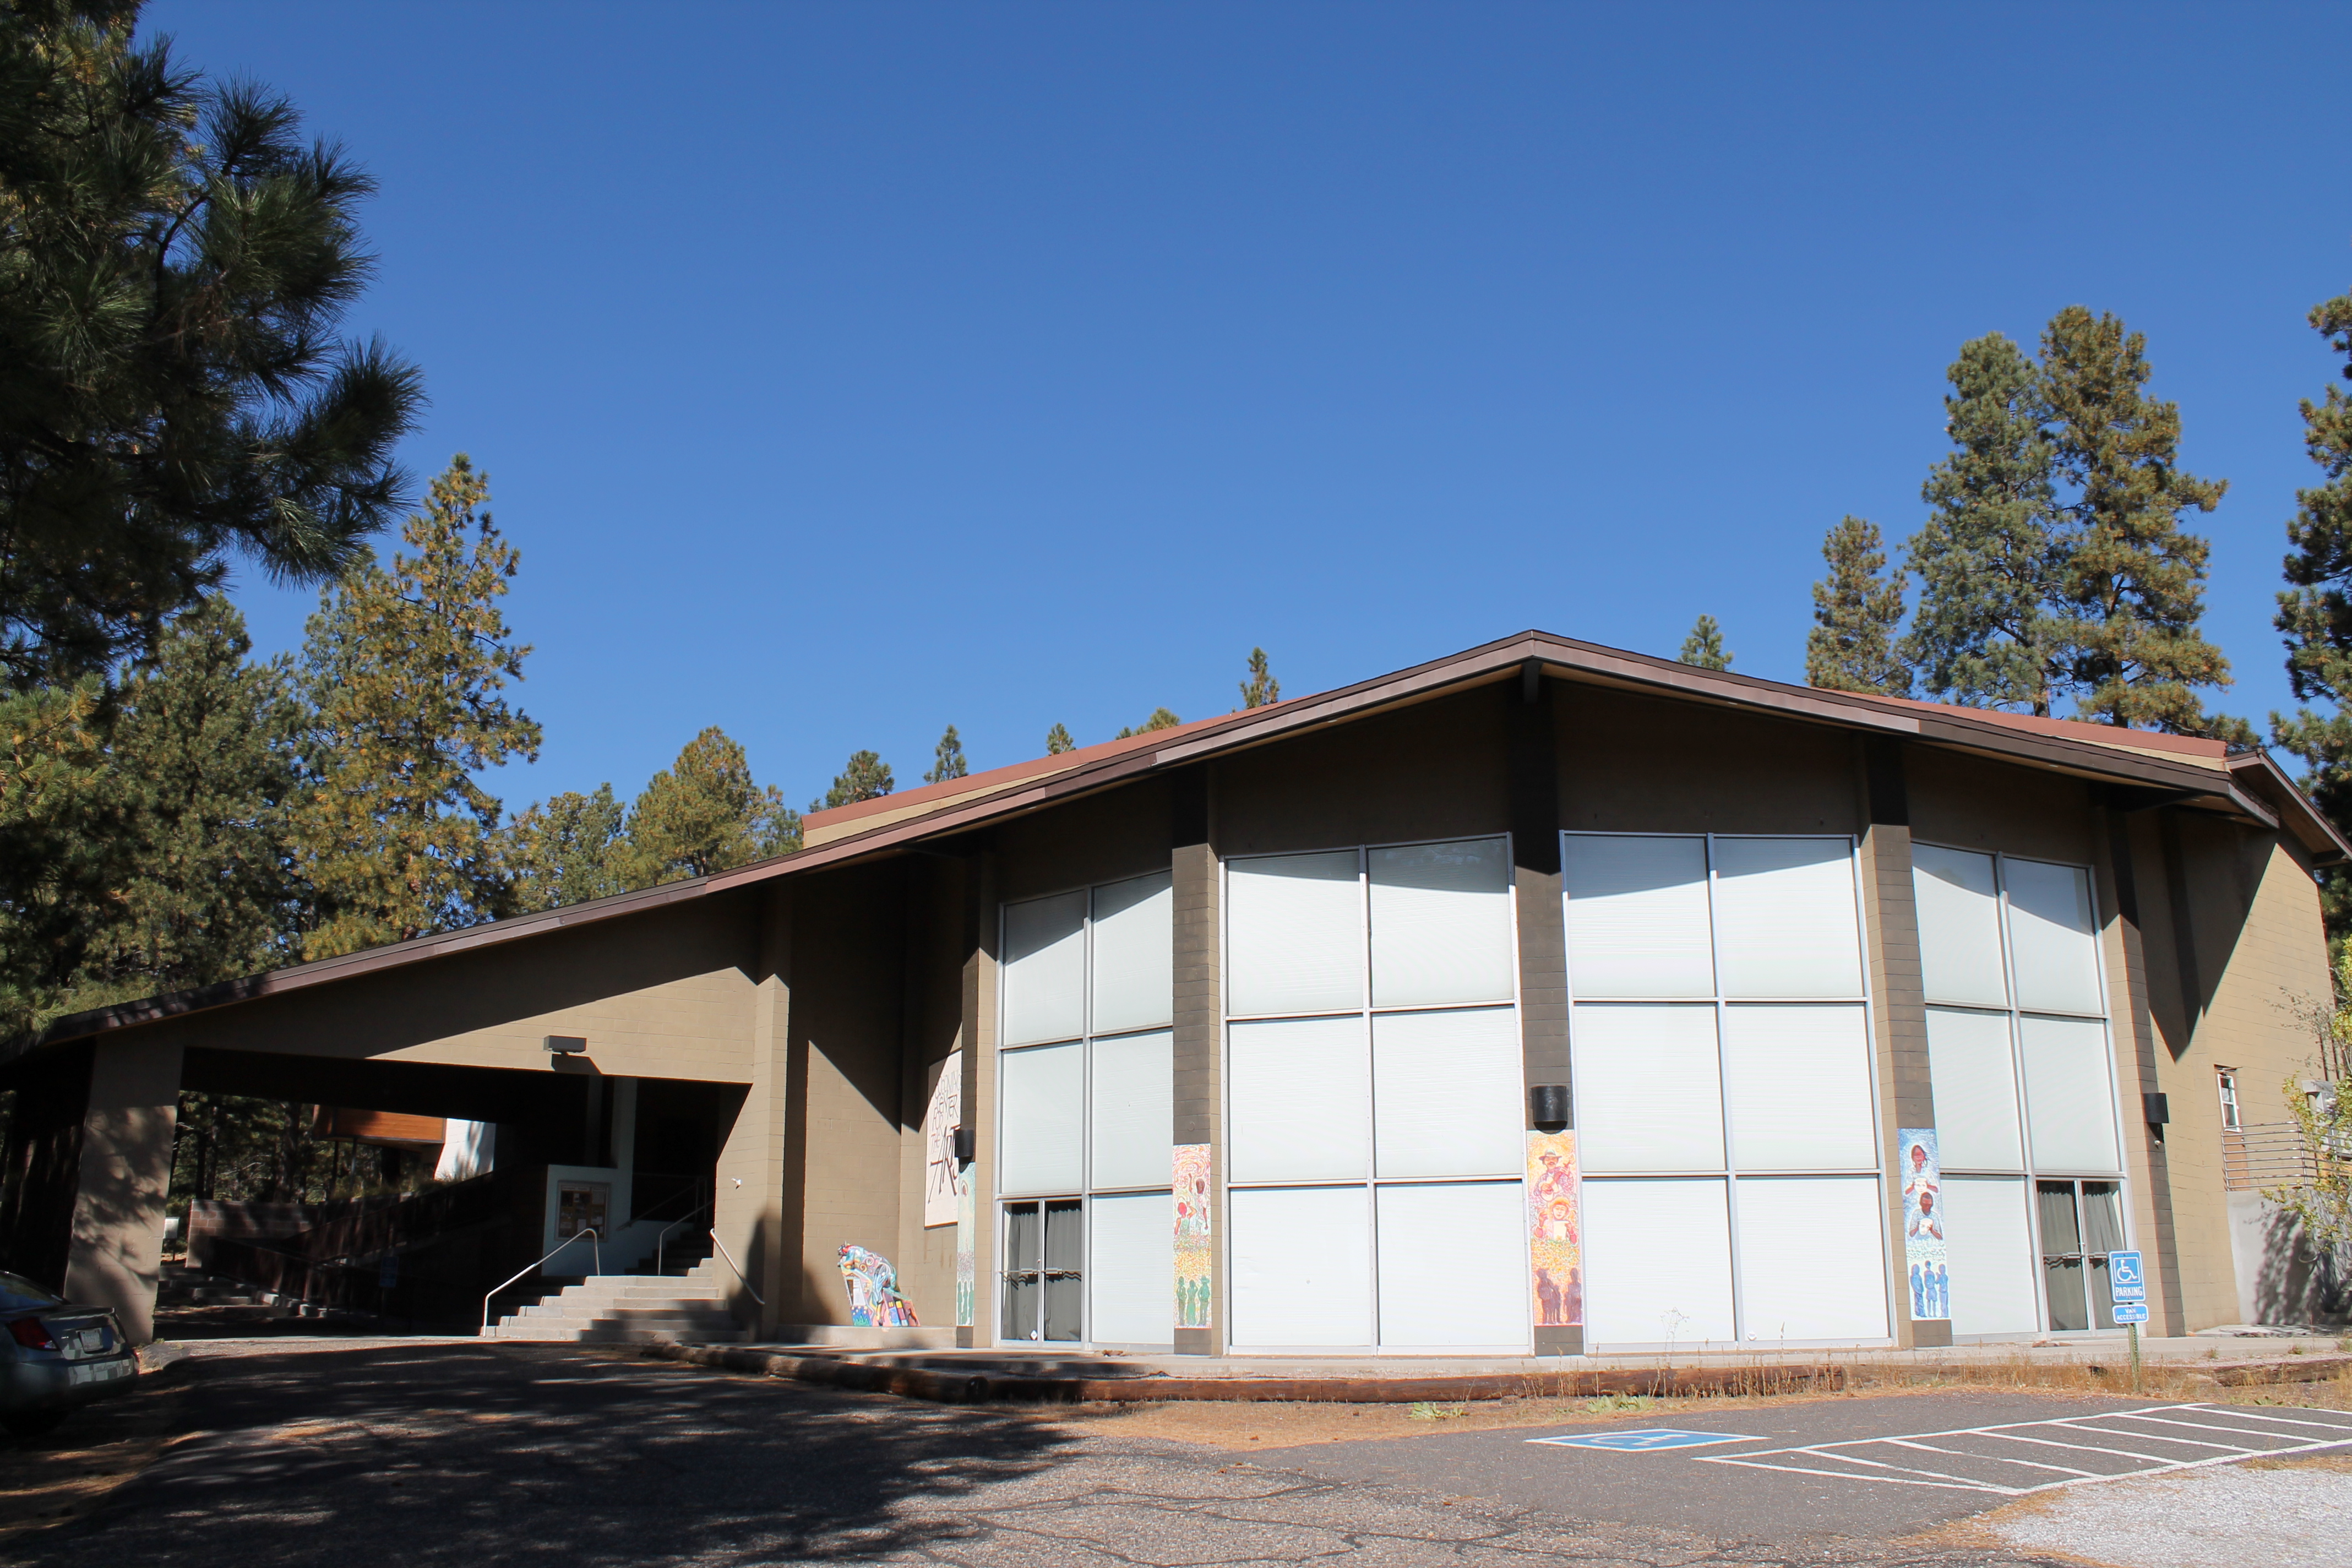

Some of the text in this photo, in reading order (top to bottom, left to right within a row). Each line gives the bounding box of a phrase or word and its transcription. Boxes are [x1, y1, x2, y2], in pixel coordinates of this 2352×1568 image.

[937, 1093, 959, 1120] CENTER
[932, 1107, 944, 1137] FOR
[930, 1132, 940, 1153] THE
[2115, 1286, 2143, 1297] PARKING
